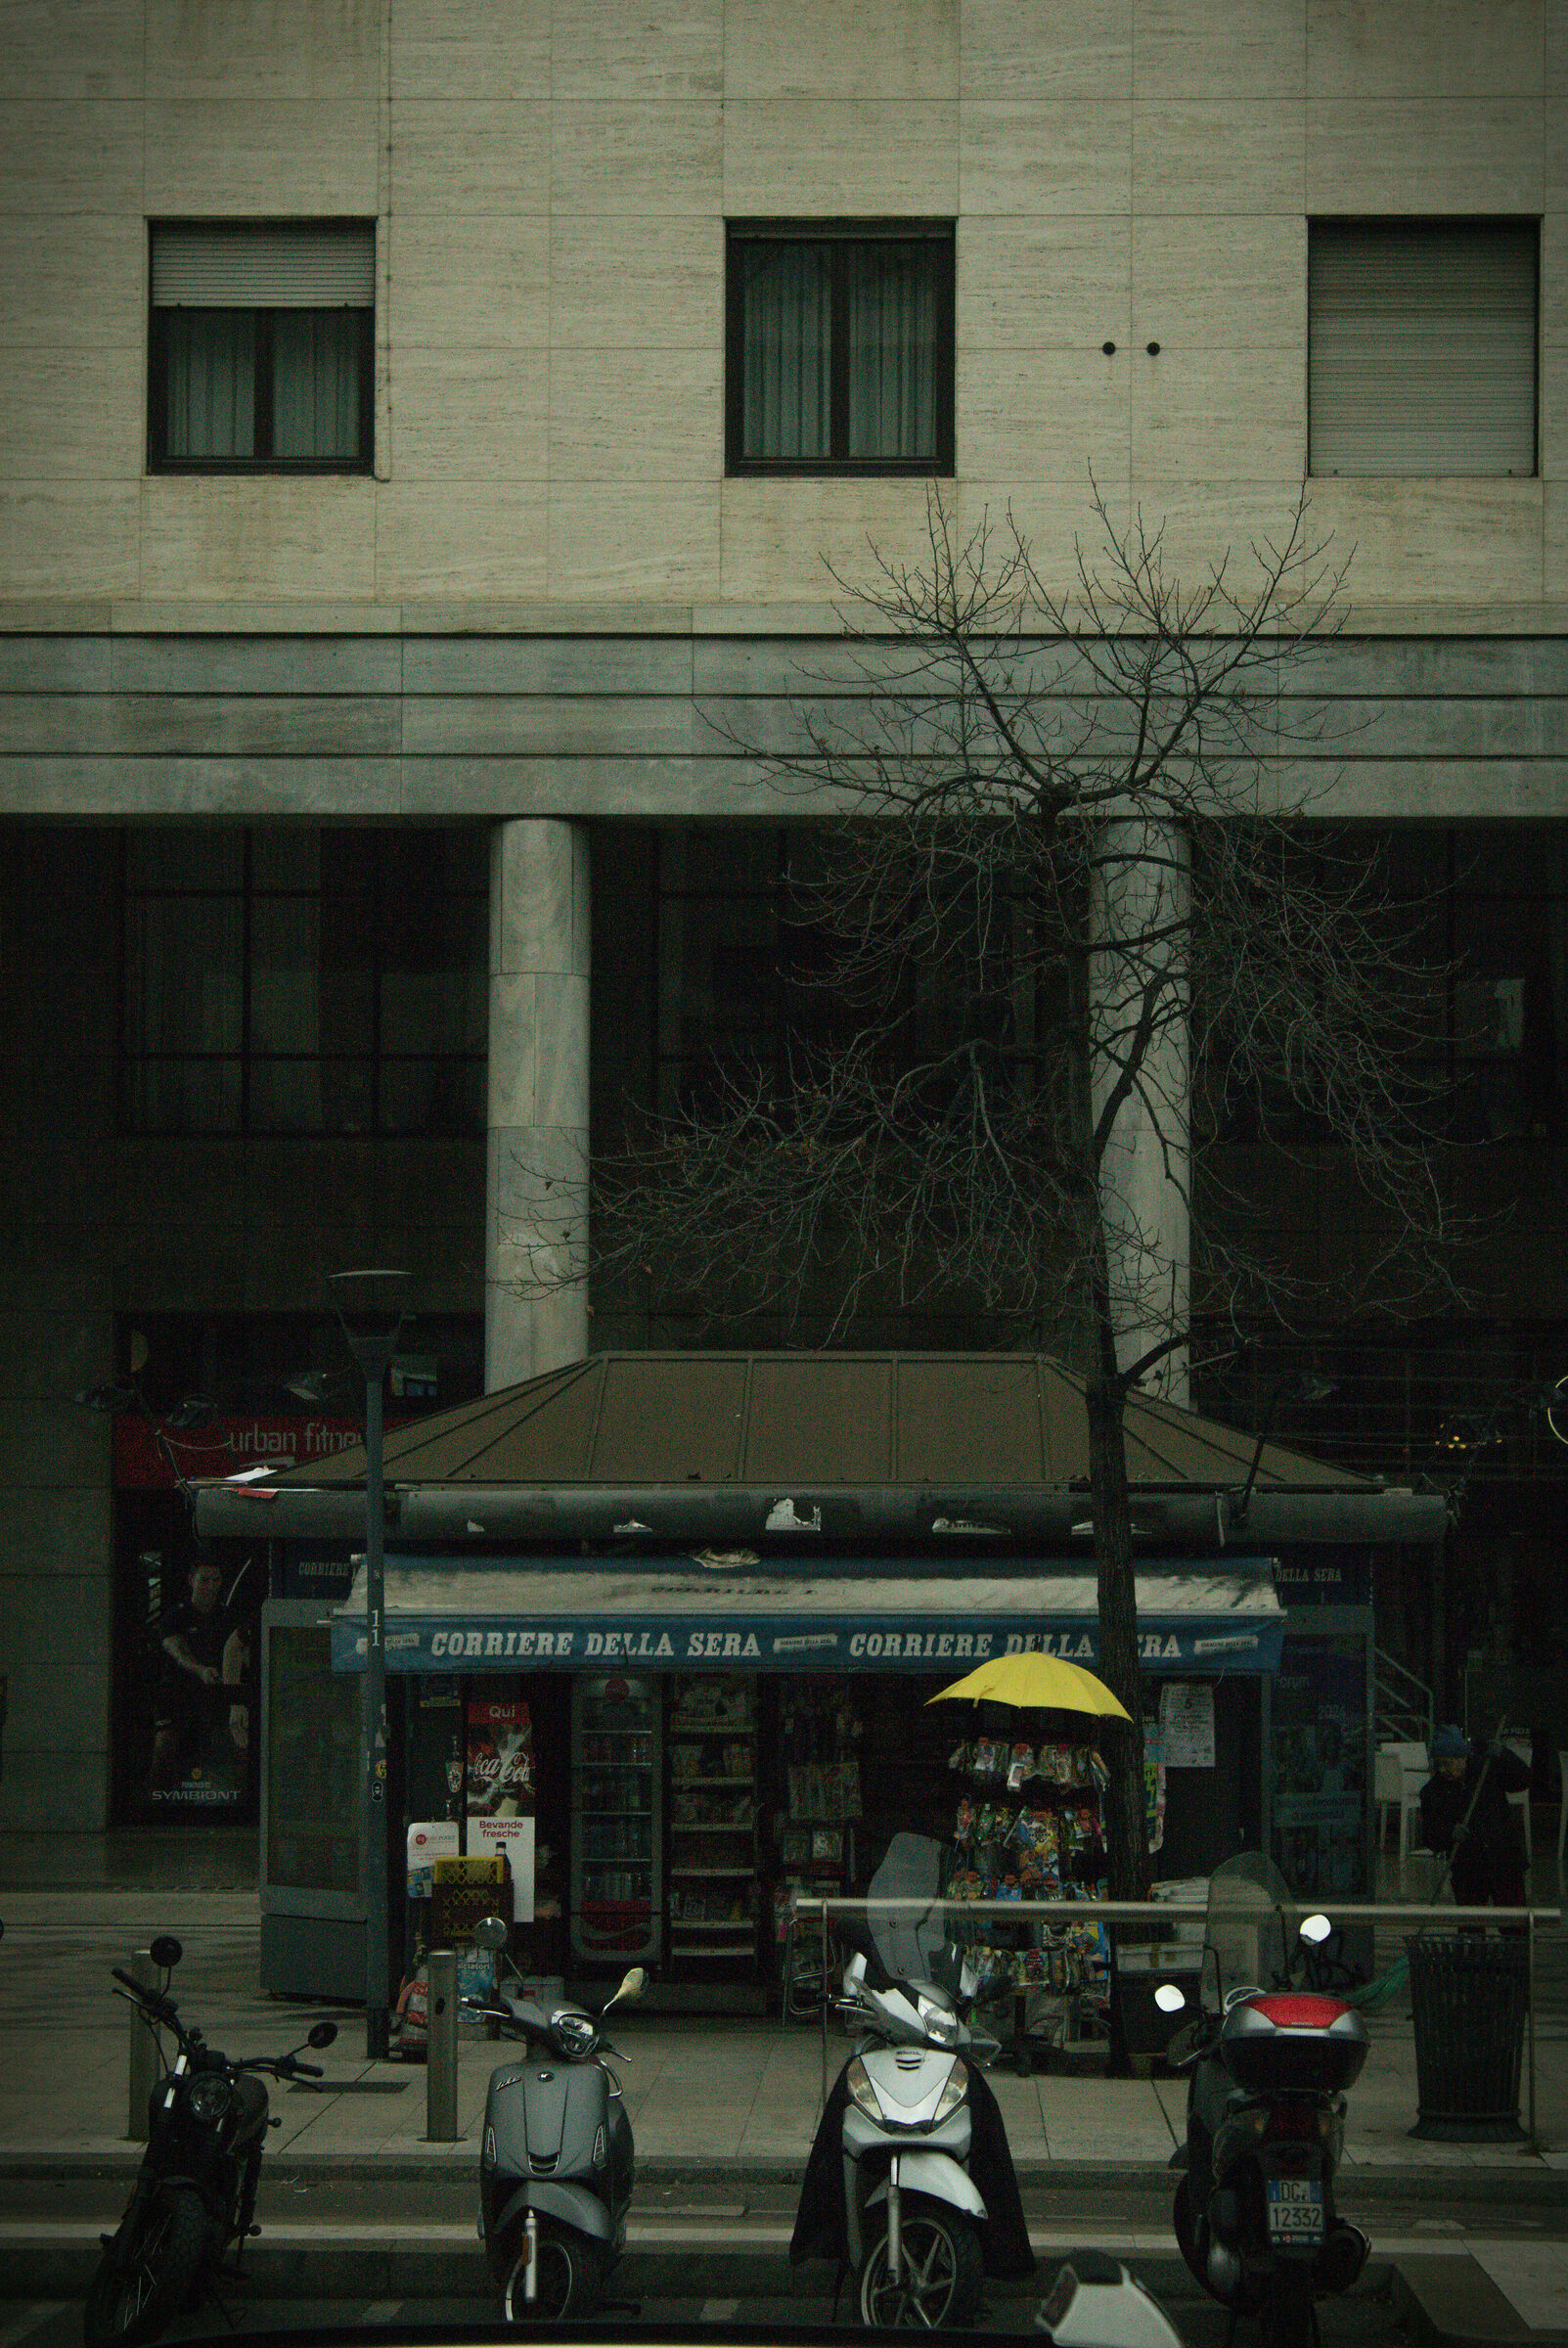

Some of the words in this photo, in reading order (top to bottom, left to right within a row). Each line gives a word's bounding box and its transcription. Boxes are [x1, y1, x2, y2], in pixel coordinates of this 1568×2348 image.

[229, 1422, 295, 1452] urban
[1314, 1567, 1342, 1583] SERA
[430, 1632, 573, 1656] CORRIERE
[585, 1632, 675, 1656] DELLA
[687, 1632, 761, 1656] SERA
[849, 1633, 994, 1657] CORRIERE
[1004, 1633, 1095, 1657] DELLA
[1137, 1634, 1182, 1657] RA
[489, 1705, 515, 1719] Qui
[152, 1789, 241, 1801] SYMBIONT
[479, 1820, 523, 1829] Bevande
[482, 1829, 520, 1837] fresche
[1273, 2206, 1322, 2228] 12332
